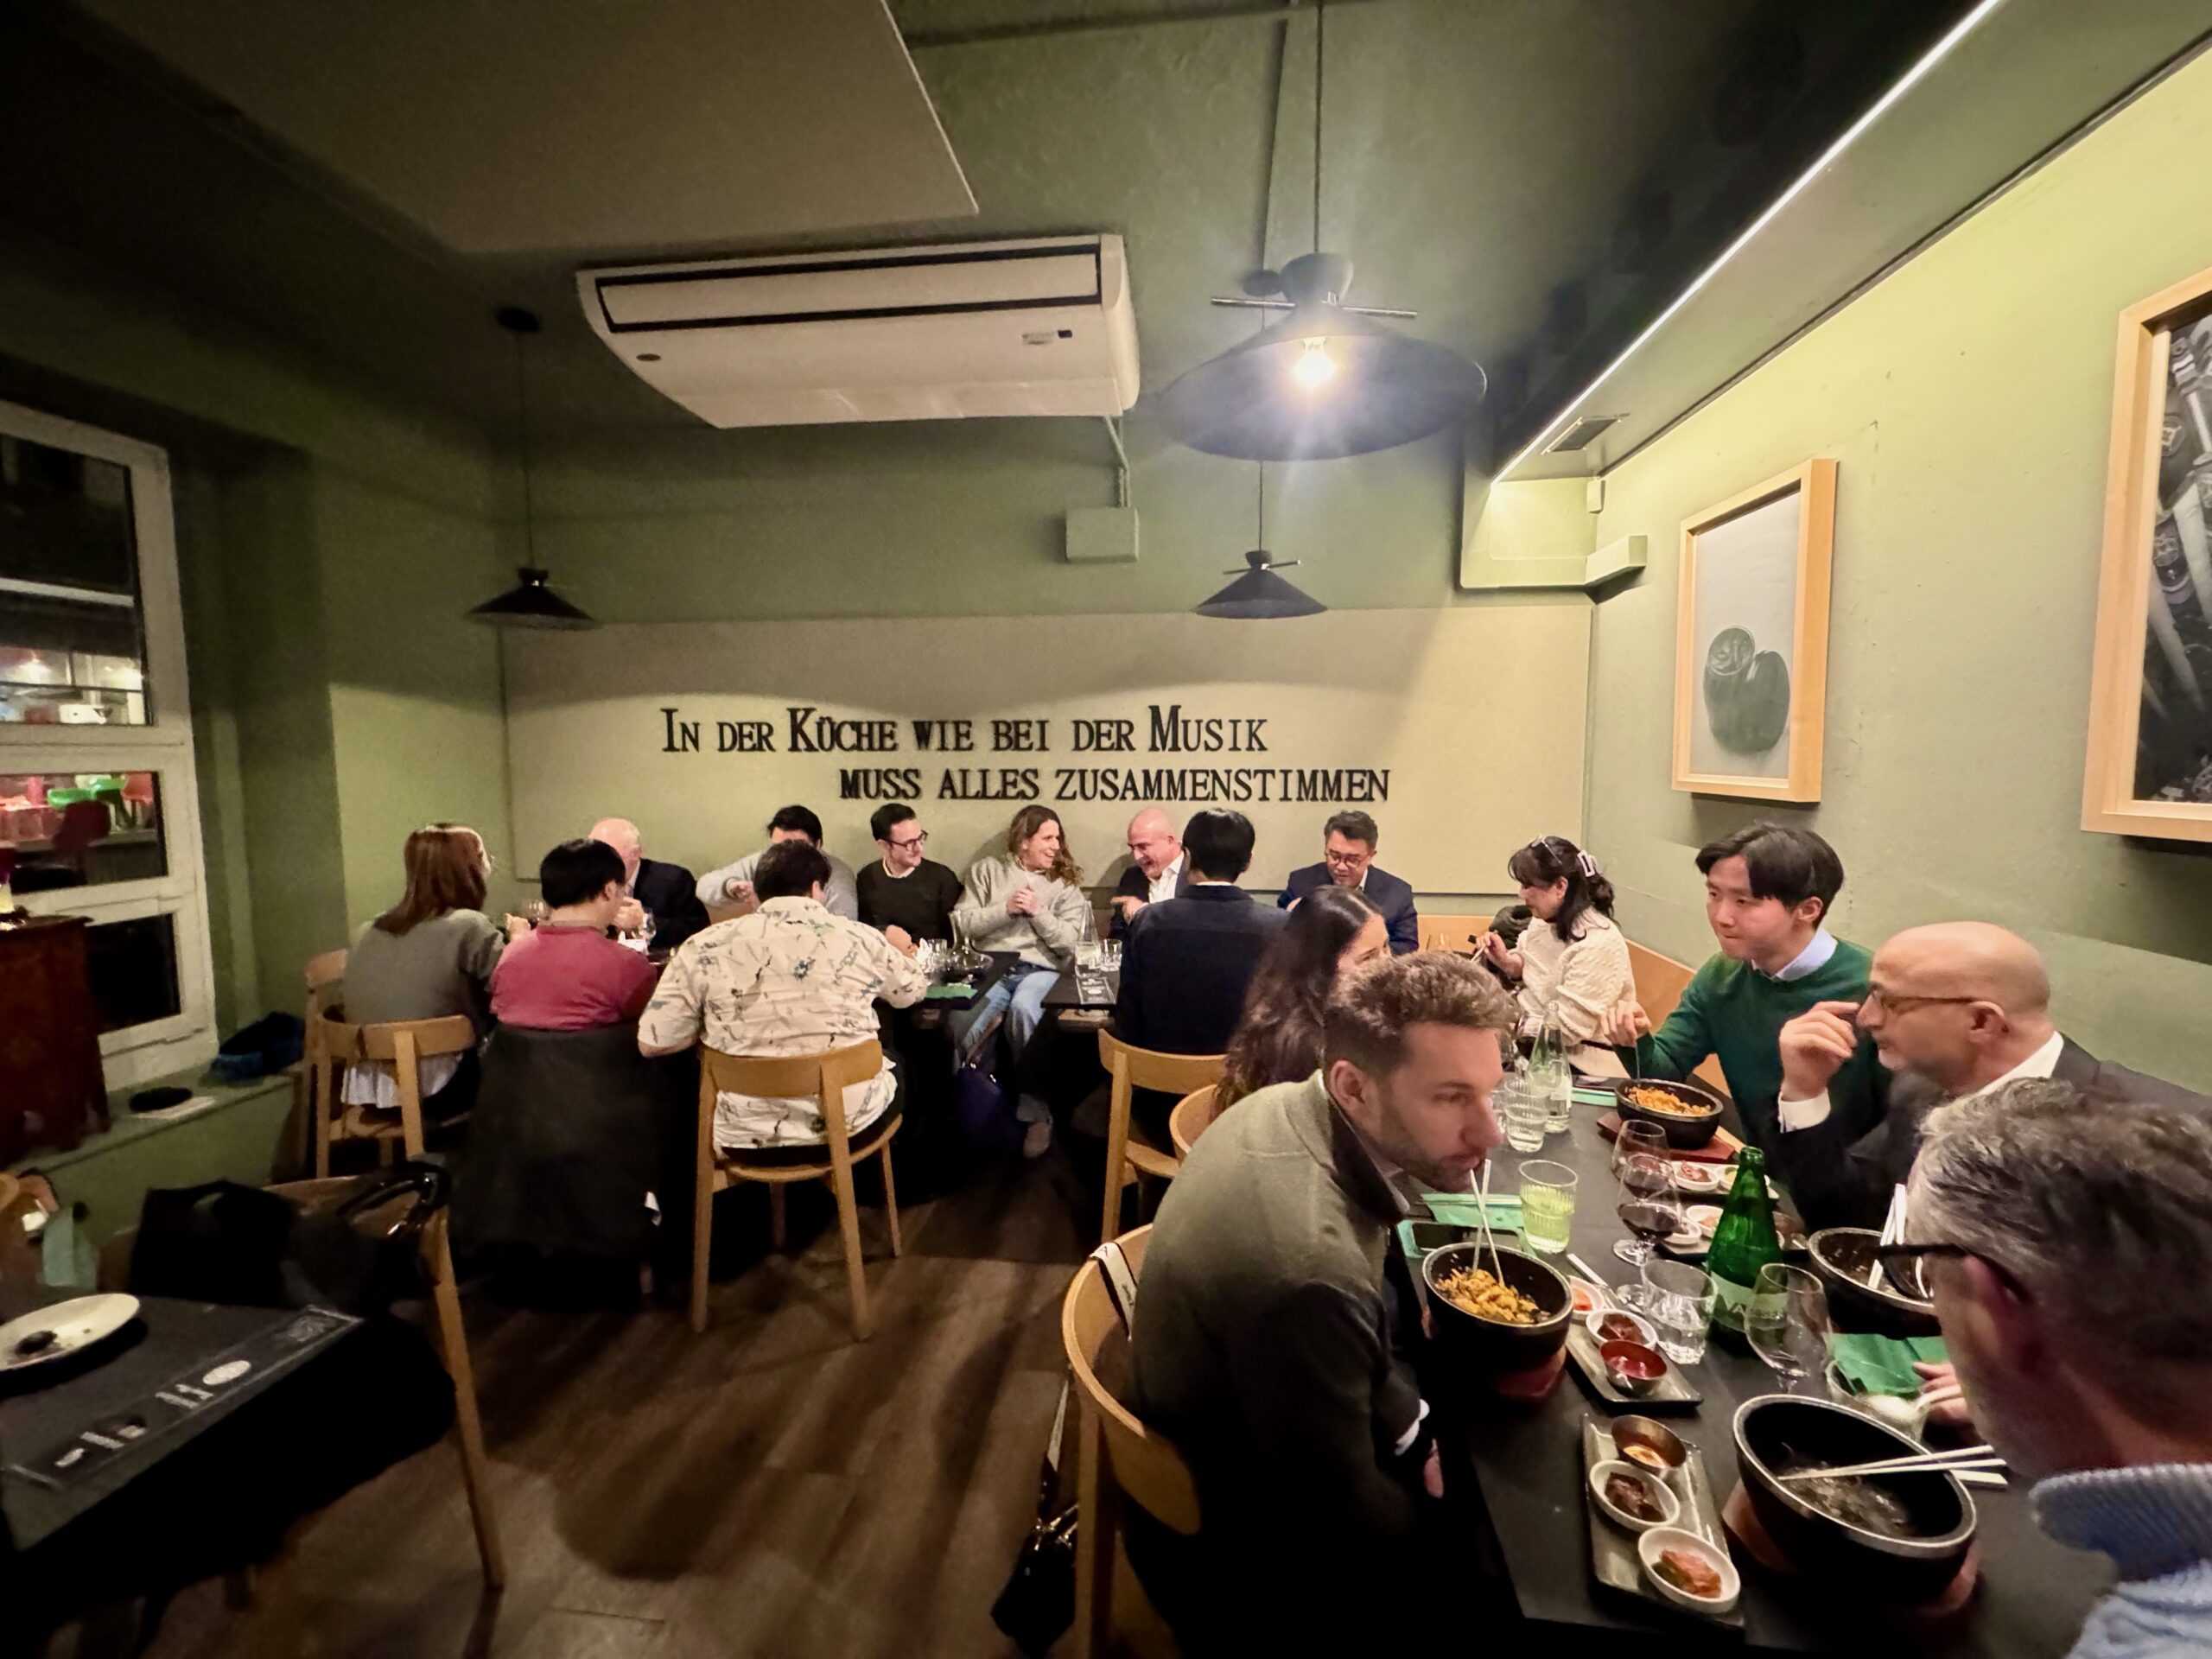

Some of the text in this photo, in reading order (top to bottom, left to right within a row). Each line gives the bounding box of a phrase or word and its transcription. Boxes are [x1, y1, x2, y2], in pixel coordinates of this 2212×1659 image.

[661, 709, 700, 753] IN
[717, 721, 776, 752] DER
[912, 720, 974, 752] WIE
[991, 720, 1050, 752] BEI
[1072, 720, 1135, 752] DER
[1148, 705, 1268, 752] MUSIK
[840, 769, 1390, 802] MUSS ALLES ZUSAMMENSTIMMEN
